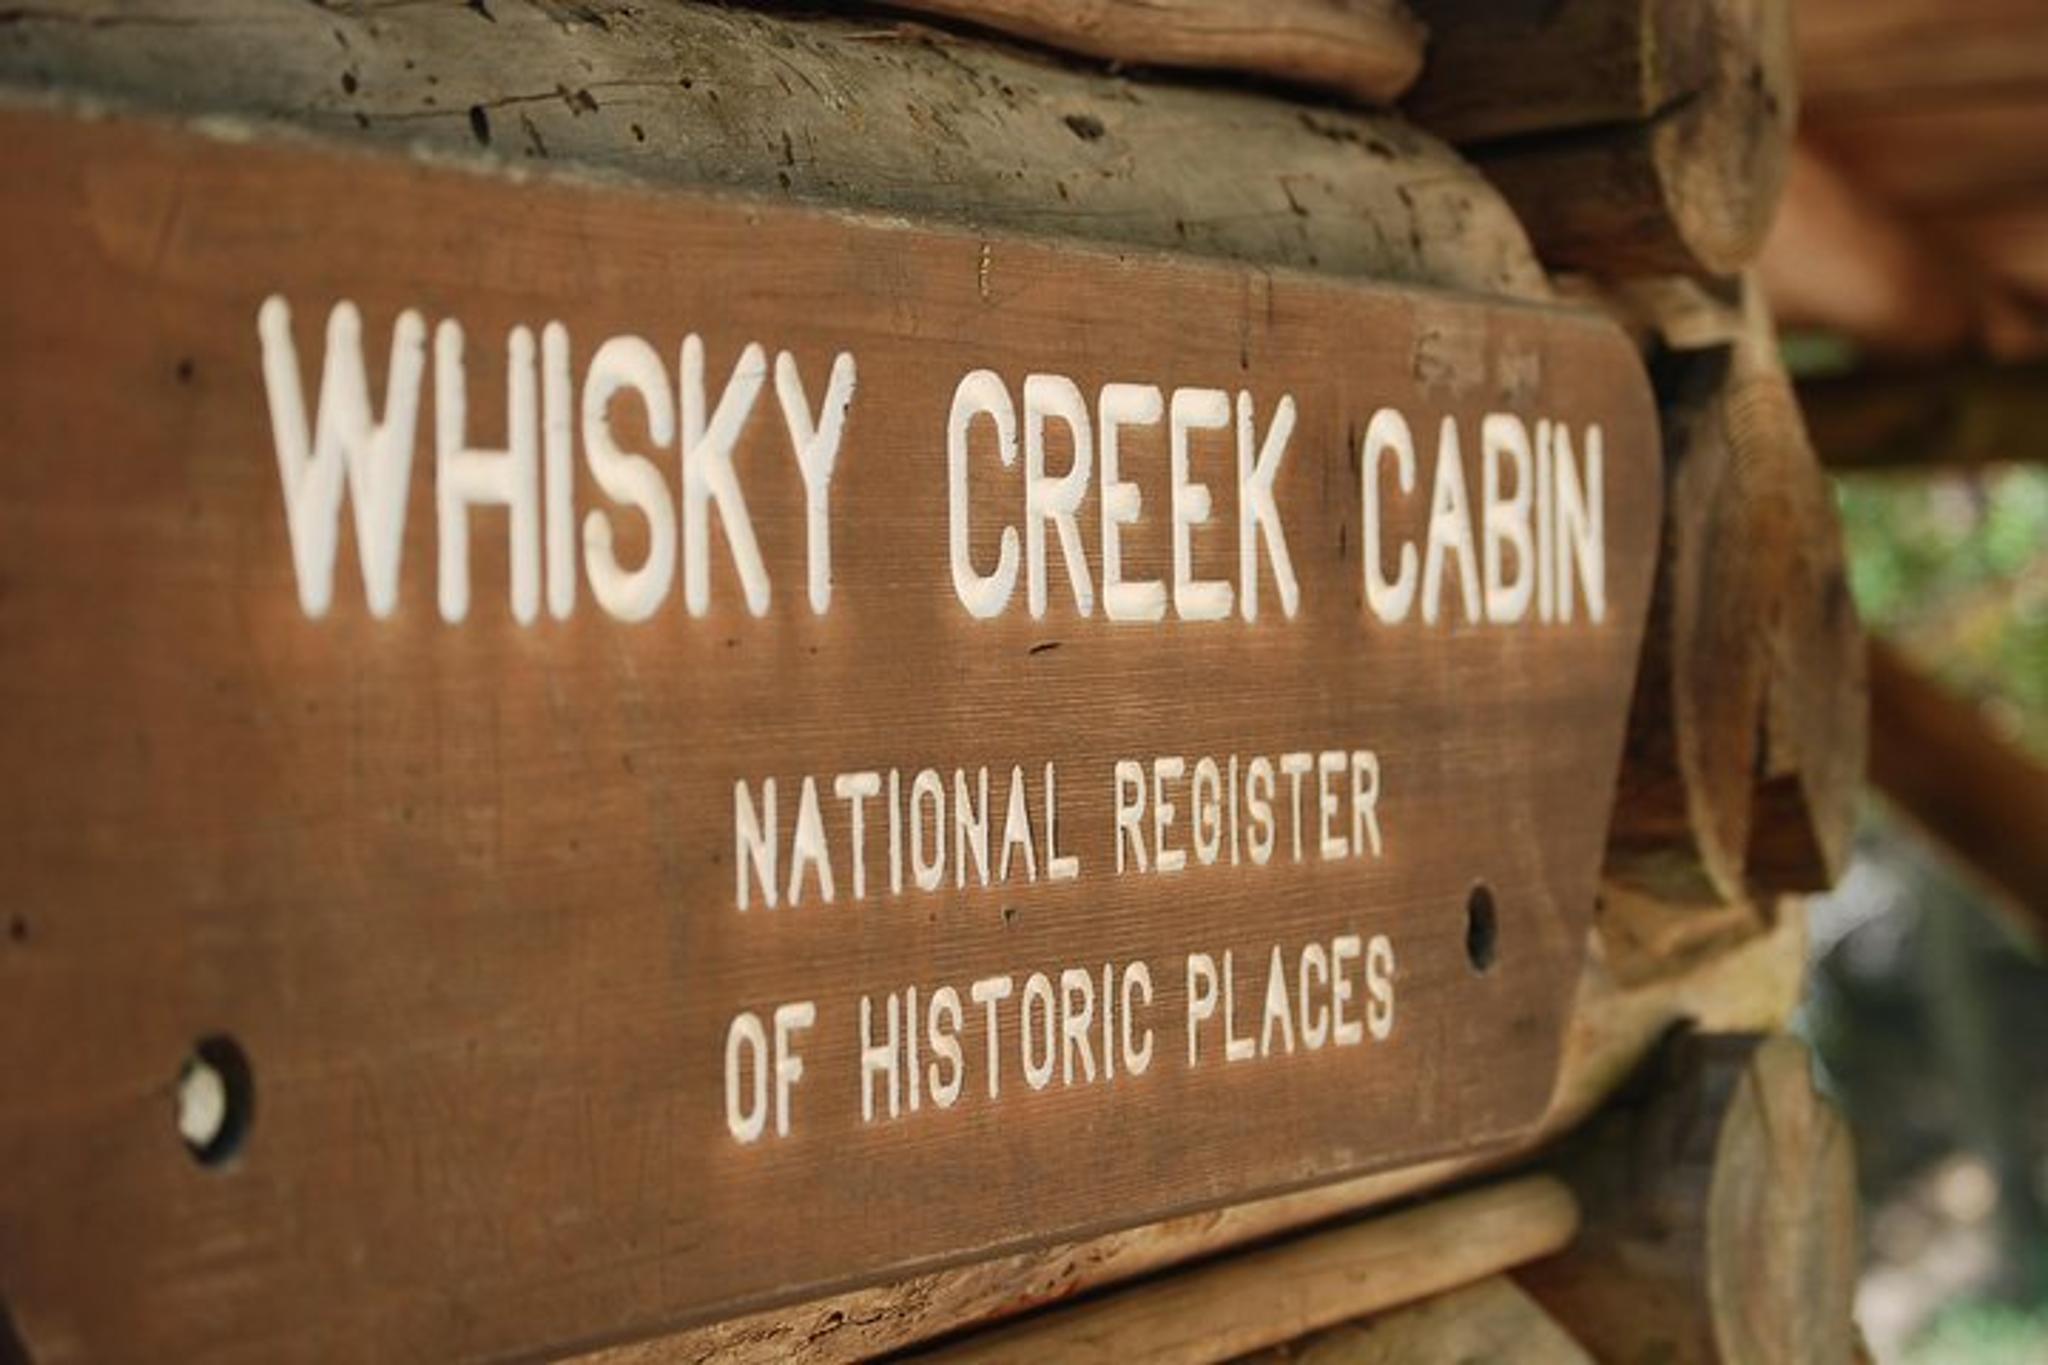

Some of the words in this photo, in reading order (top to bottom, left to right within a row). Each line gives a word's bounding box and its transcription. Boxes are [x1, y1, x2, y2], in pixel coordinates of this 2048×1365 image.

[259, 295, 857, 626] WHISKY
[946, 369, 1300, 624] CREEK
[1361, 409, 1605, 624] CABIN
[734, 763, 1080, 911] NATIONAL
[1114, 750, 1381, 876] REGISTER
[725, 1002, 817, 1144] OF
[860, 960, 1154, 1122] HISTORIC
[1186, 935, 1396, 1068] PLACES
